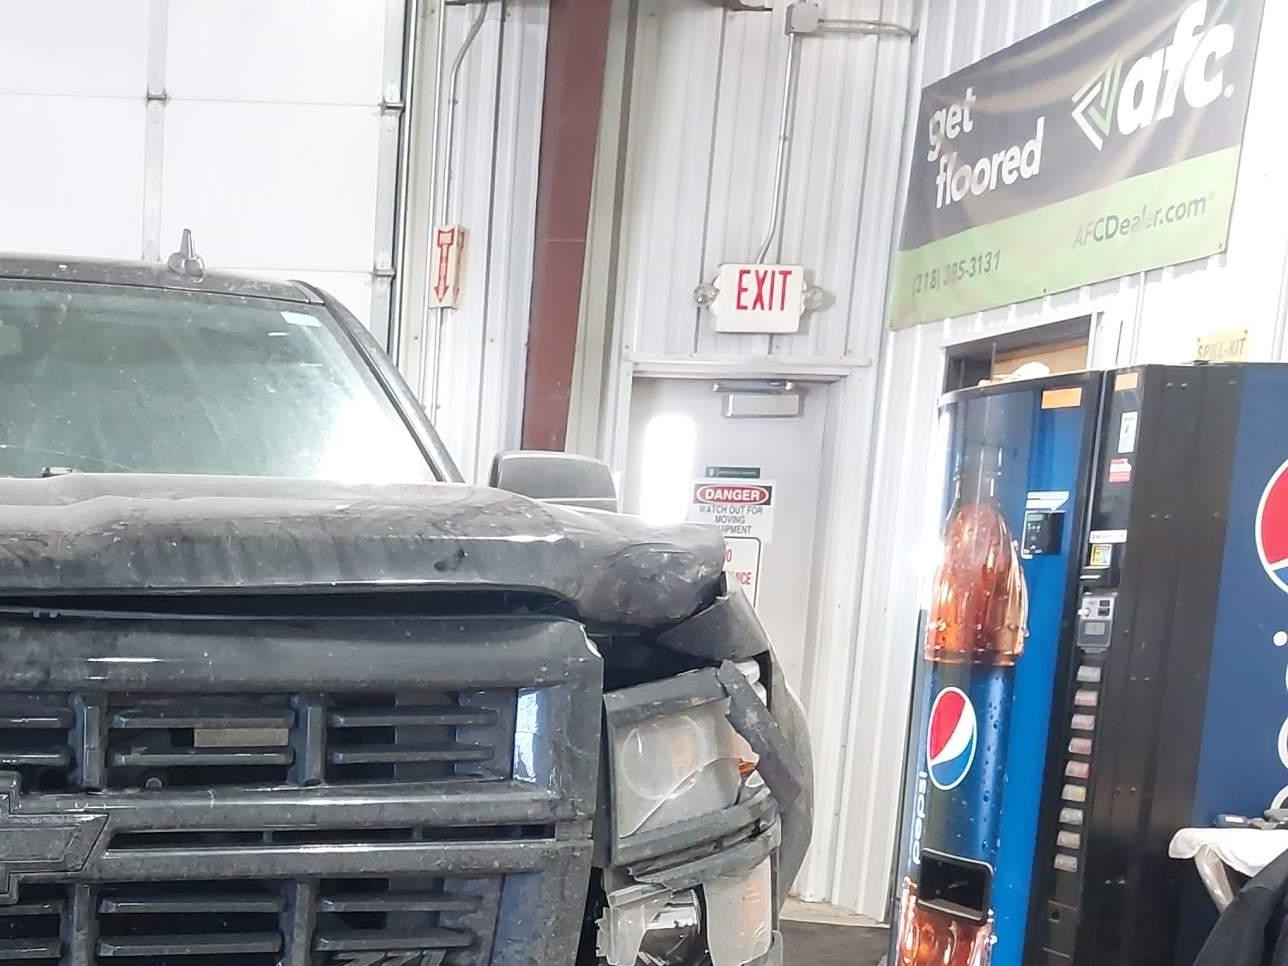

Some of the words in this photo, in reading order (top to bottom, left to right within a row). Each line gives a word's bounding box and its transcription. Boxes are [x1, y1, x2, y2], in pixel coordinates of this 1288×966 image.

[927, 87, 977, 162] get
[935, 116, 1046, 209] floored
[735, 269, 793, 312] EXIT
[699, 505, 727, 515] WATCH
[729, 505, 746, 515] OUT
[747, 506, 764, 516] FOR
[704, 488, 761, 502] DANGER
[714, 515, 746, 525] MOVING
[912, 770, 928, 865] pepsi
